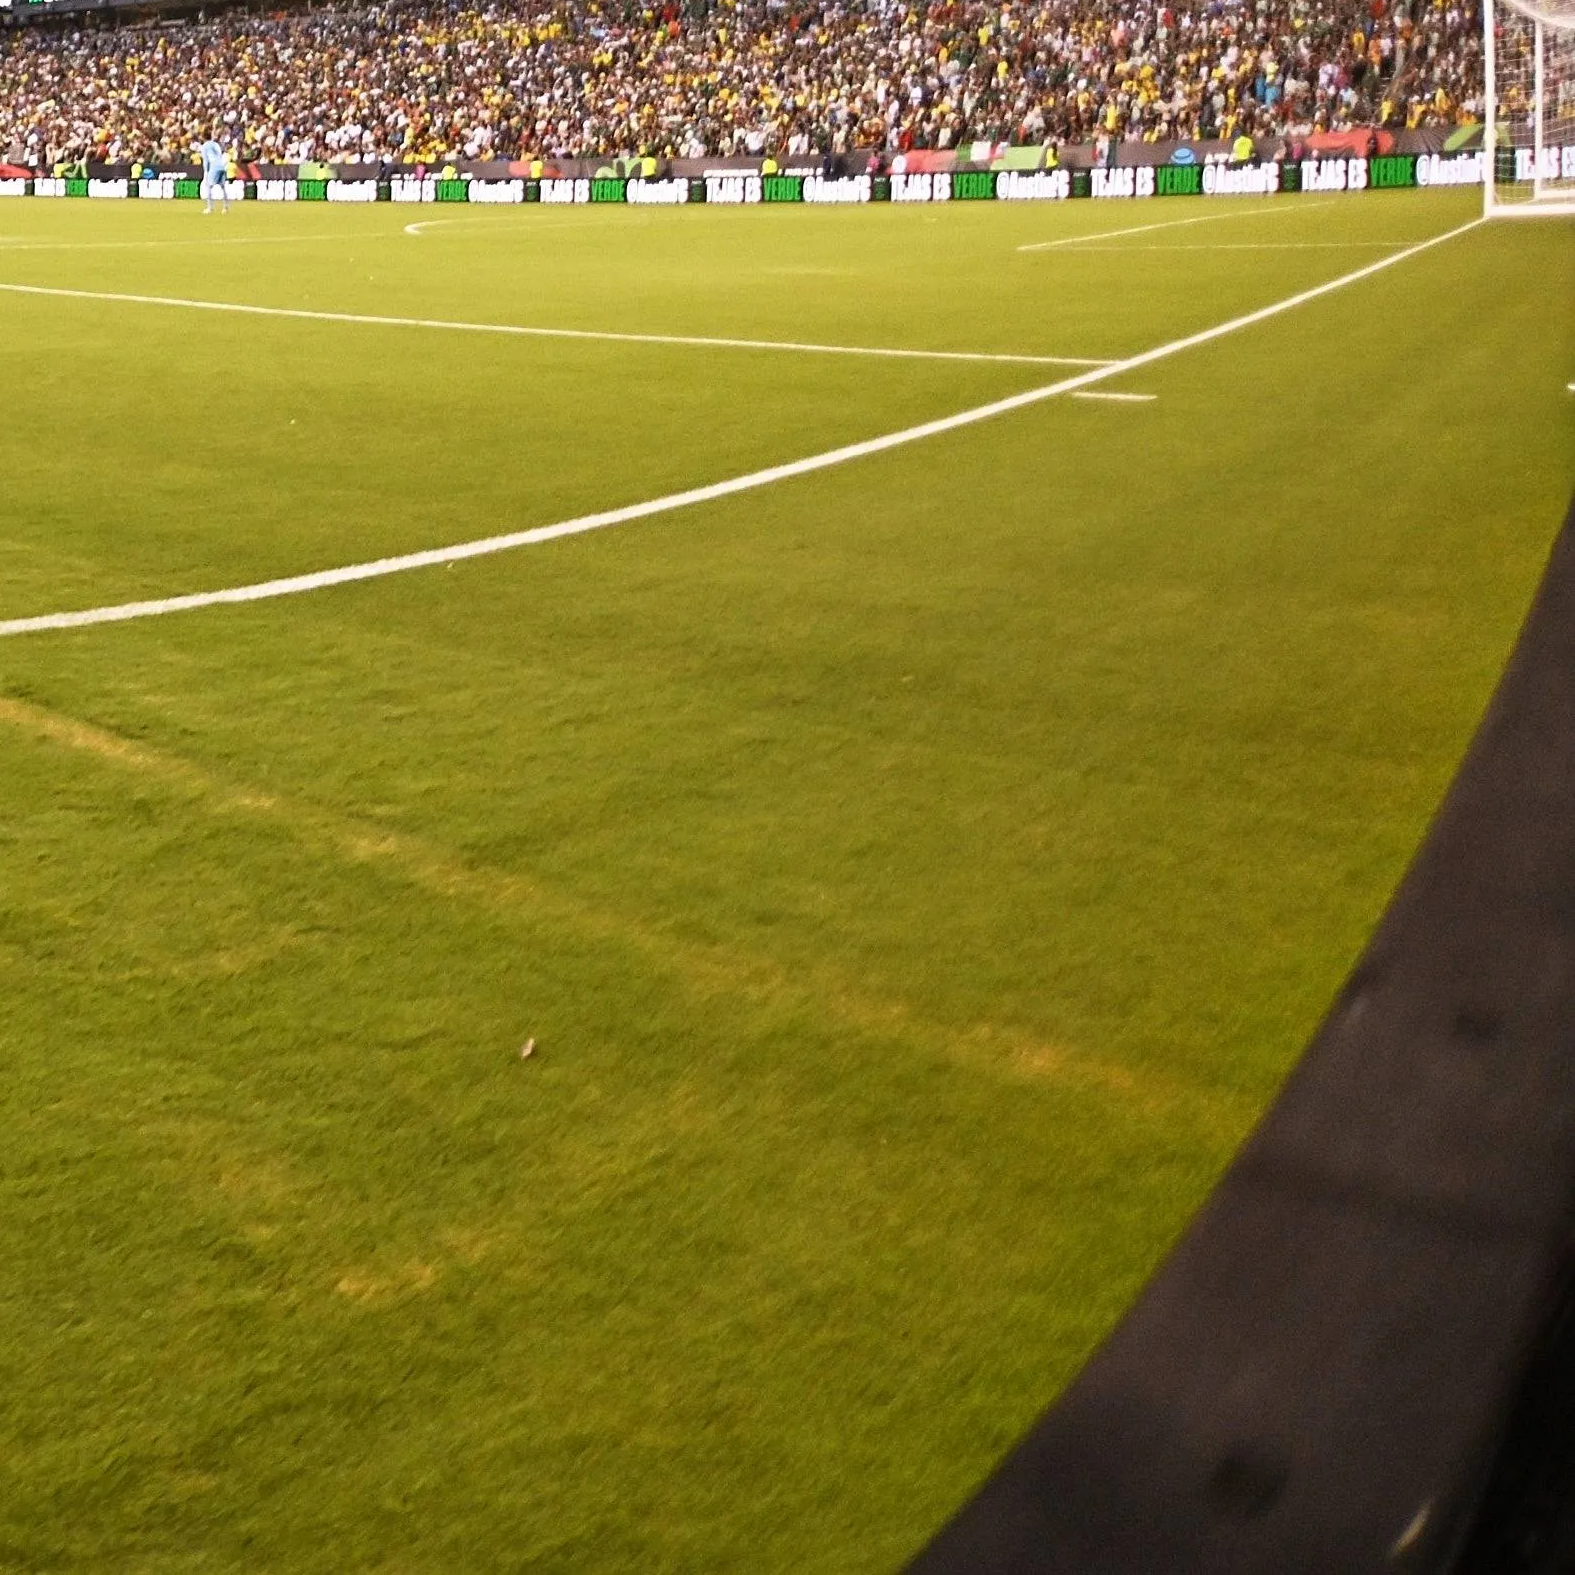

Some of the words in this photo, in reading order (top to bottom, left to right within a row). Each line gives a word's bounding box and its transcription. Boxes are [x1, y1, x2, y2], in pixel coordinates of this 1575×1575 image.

[1090, 167, 1135, 196] TEJAS
[1136, 166, 1154, 195] ES
[1157, 167, 1199, 194] VERDE
[1300, 160, 1346, 190] TEJAS
[1348, 158, 1367, 188] ES
[1370, 159, 1413, 186] VERDE
[1416, 152, 1488, 185] @AustinF
[592, 180, 625, 201] VERDE
[764, 178, 801, 201] VERDE
[890, 174, 932, 201] TEJAS
[933, 173, 951, 200] ES
[954, 175, 993, 199] VERDE
